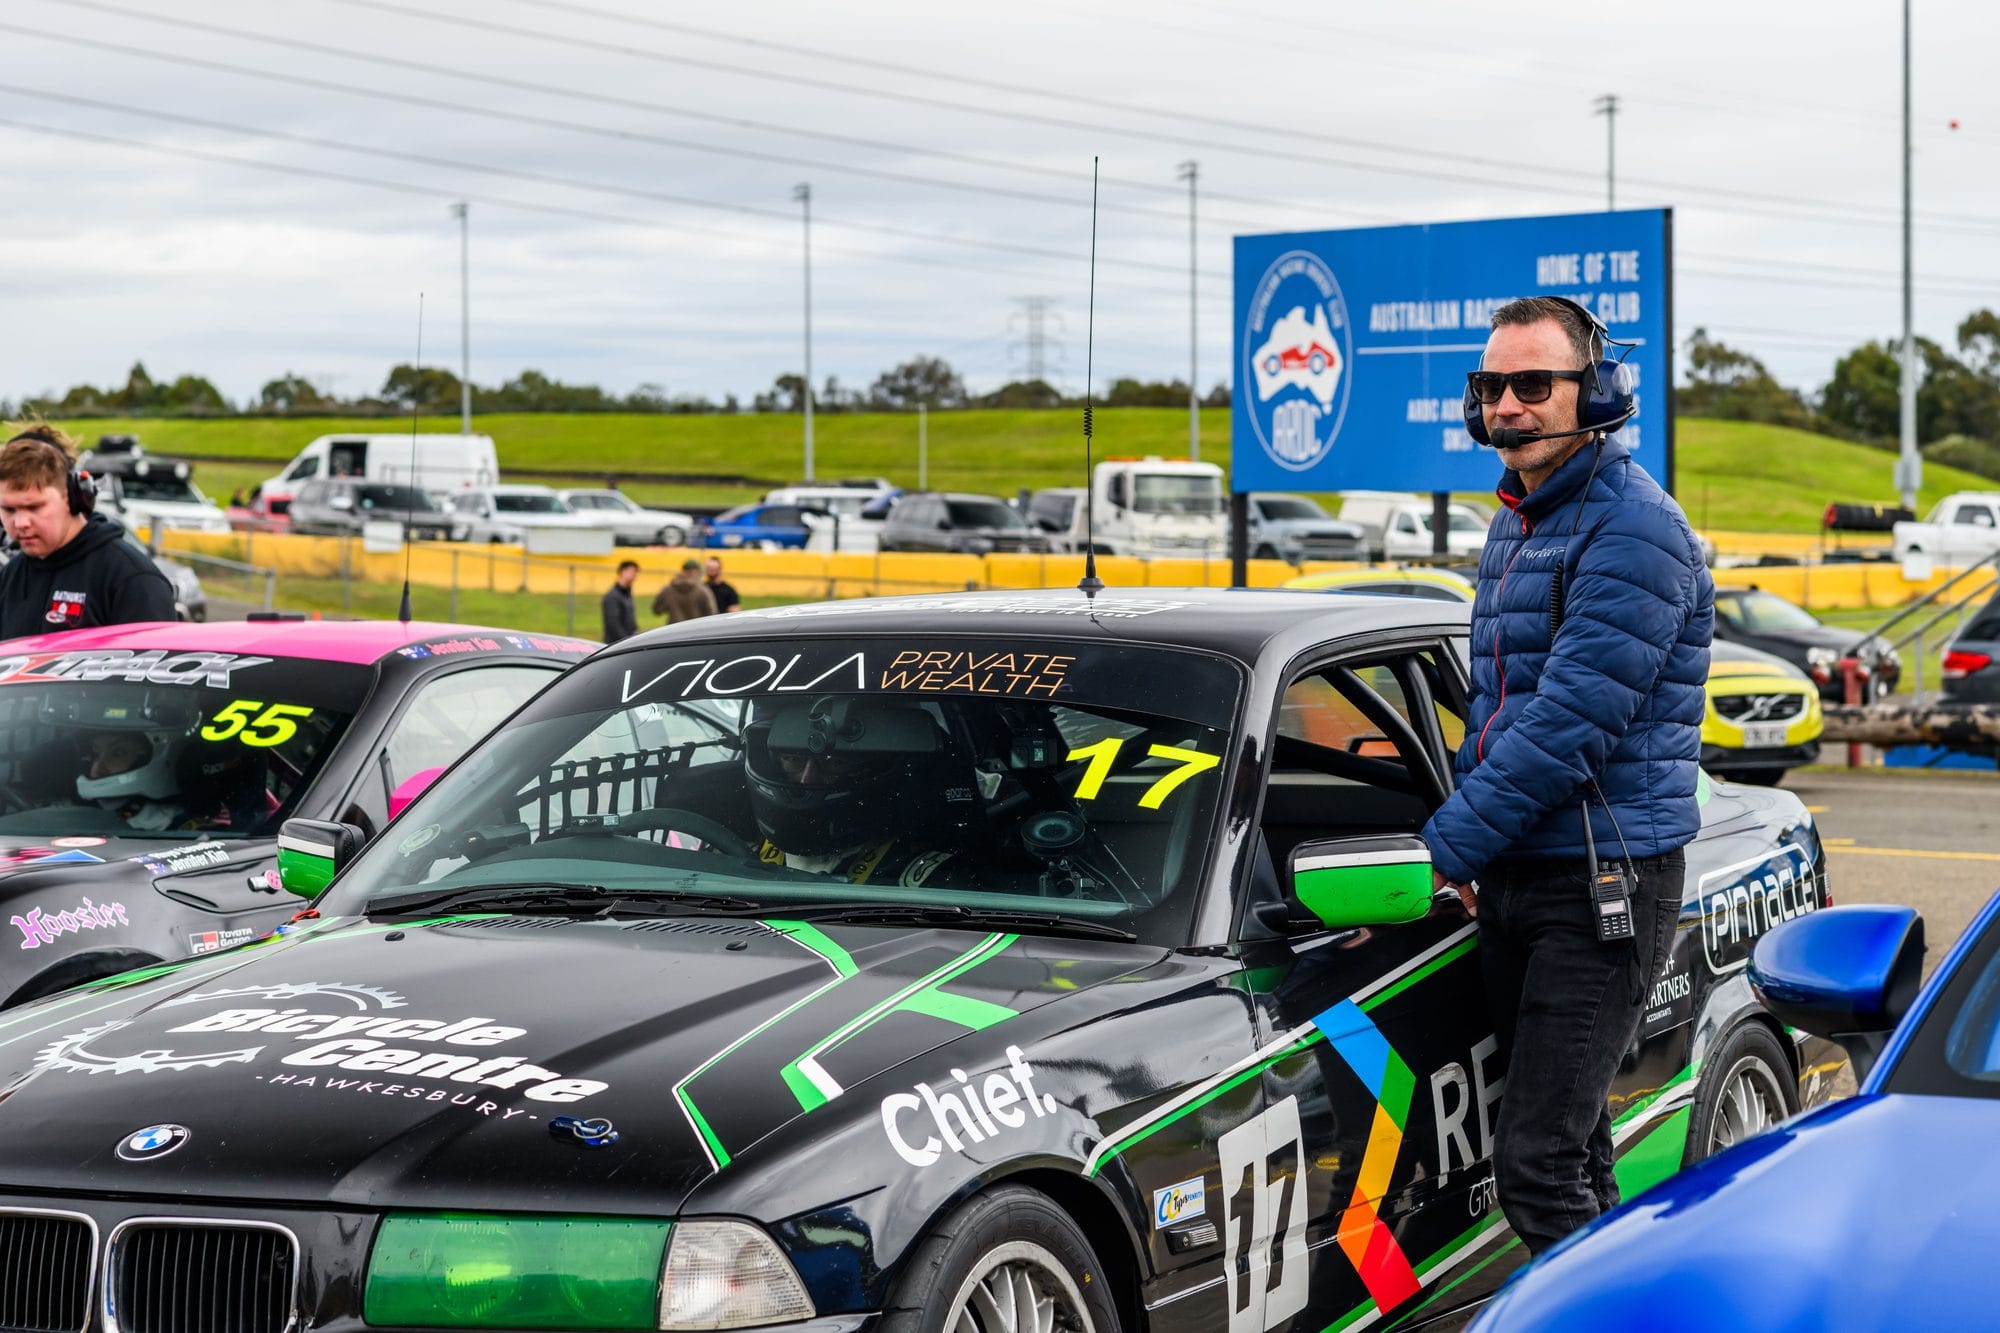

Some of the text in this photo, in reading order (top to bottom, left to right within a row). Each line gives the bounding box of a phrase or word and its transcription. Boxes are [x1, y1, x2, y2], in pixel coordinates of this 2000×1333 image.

[1537, 250, 1640, 286] HOME OF THE
[1370, 302, 1460, 332] AUSTRALIAN
[1598, 292, 1640, 323] CLUB
[621, 651, 1077, 703] VIOLA PRIVATE
[880, 670, 1064, 697] WEALTH
[200, 699, 315, 748] 55
[1065, 737, 1222, 810] 17
[166, 850, 230, 872] Jennifer Kim
[10, 896, 129, 950] Hoosier
[219, 928, 253, 939] TOYOTA
[1645, 972, 1690, 1010] ARTNERS
[165, 1008, 528, 1047] Bicycle
[281, 1037, 609, 1103] Centre
[881, 1045, 1057, 1167] Chief.
[1230, 1137, 1298, 1314] 17
